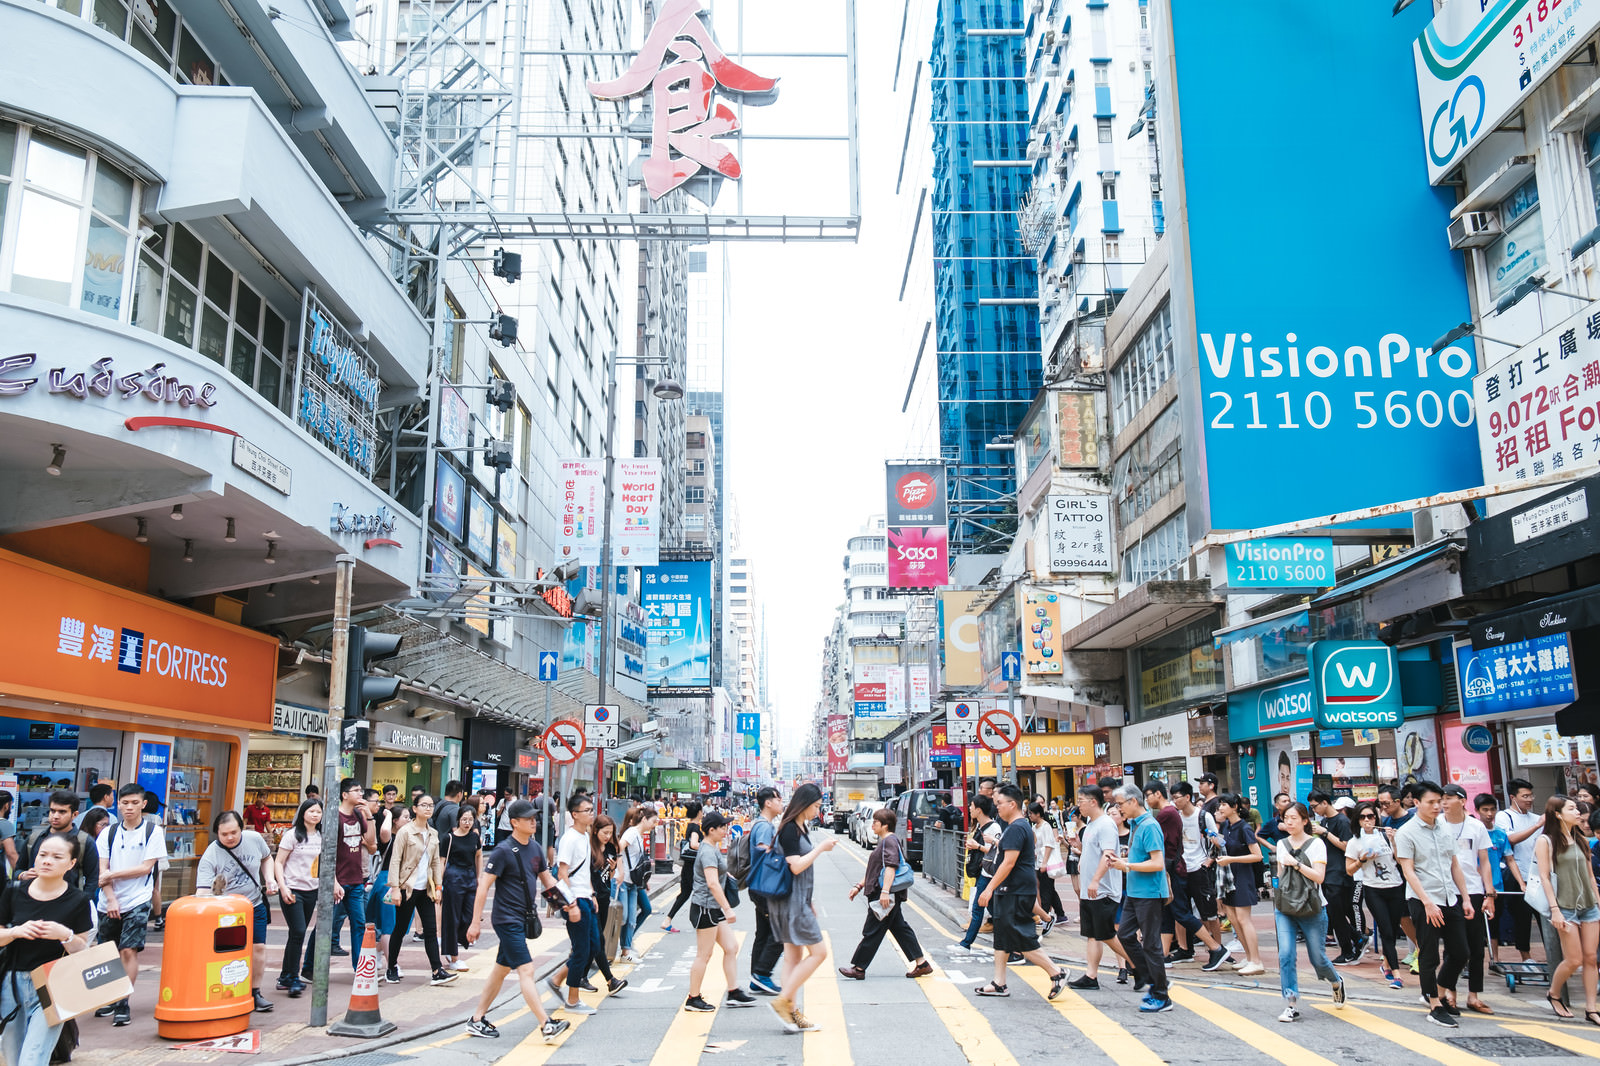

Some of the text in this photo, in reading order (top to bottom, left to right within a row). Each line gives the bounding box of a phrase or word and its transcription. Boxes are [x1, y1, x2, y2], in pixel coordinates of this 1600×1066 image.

[587, 0, 780, 201] 食
[1200, 332, 1472, 379] VisionPro
[1210, 389, 1475, 429] 2110 5600
[1495, 419, 1551, 472] 招租
[621, 482, 655, 491] World
[621, 494, 654, 502] Heart
[903, 487, 927, 498] Pizza
[907, 494, 926, 503] Hut
[1055, 499, 1098, 509] GIRL'S
[626, 505, 649, 516] Day
[1522, 512, 1537, 522] Yeung
[1537, 508, 1549, 516] Choi
[1550, 500, 1567, 512] Street
[1567, 494, 1585, 505] South
[1053, 512, 1104, 523] TATTOO
[1071, 541, 1089, 549] 2/F
[1233, 542, 1325, 562] VisionPro
[1053, 559, 1108, 567] 69996444
[1236, 564, 1326, 581] 2110 5600
[645, 602, 692, 617] 大灣區
[57, 617, 115, 663] 豐澤
[146, 639, 228, 688] FORTRESS
[1494, 644, 1570, 681] 豪大大雞排
[1469, 679, 1492, 689] HOT
[1467, 687, 1493, 697] STAR
[1265, 691, 1312, 719] watso
[1324, 711, 1398, 723] watsons
[742, 716, 755, 731] i.t
[968, 722, 973, 730] 7
[606, 726, 611, 734] 7
[606, 739, 616, 747] 12
[968, 735, 978, 743] 12
[1141, 726, 1173, 753] innisfree
[1035, 746, 1086, 758] BONJOUR
[143, 754, 166, 764] SAMSUNG
